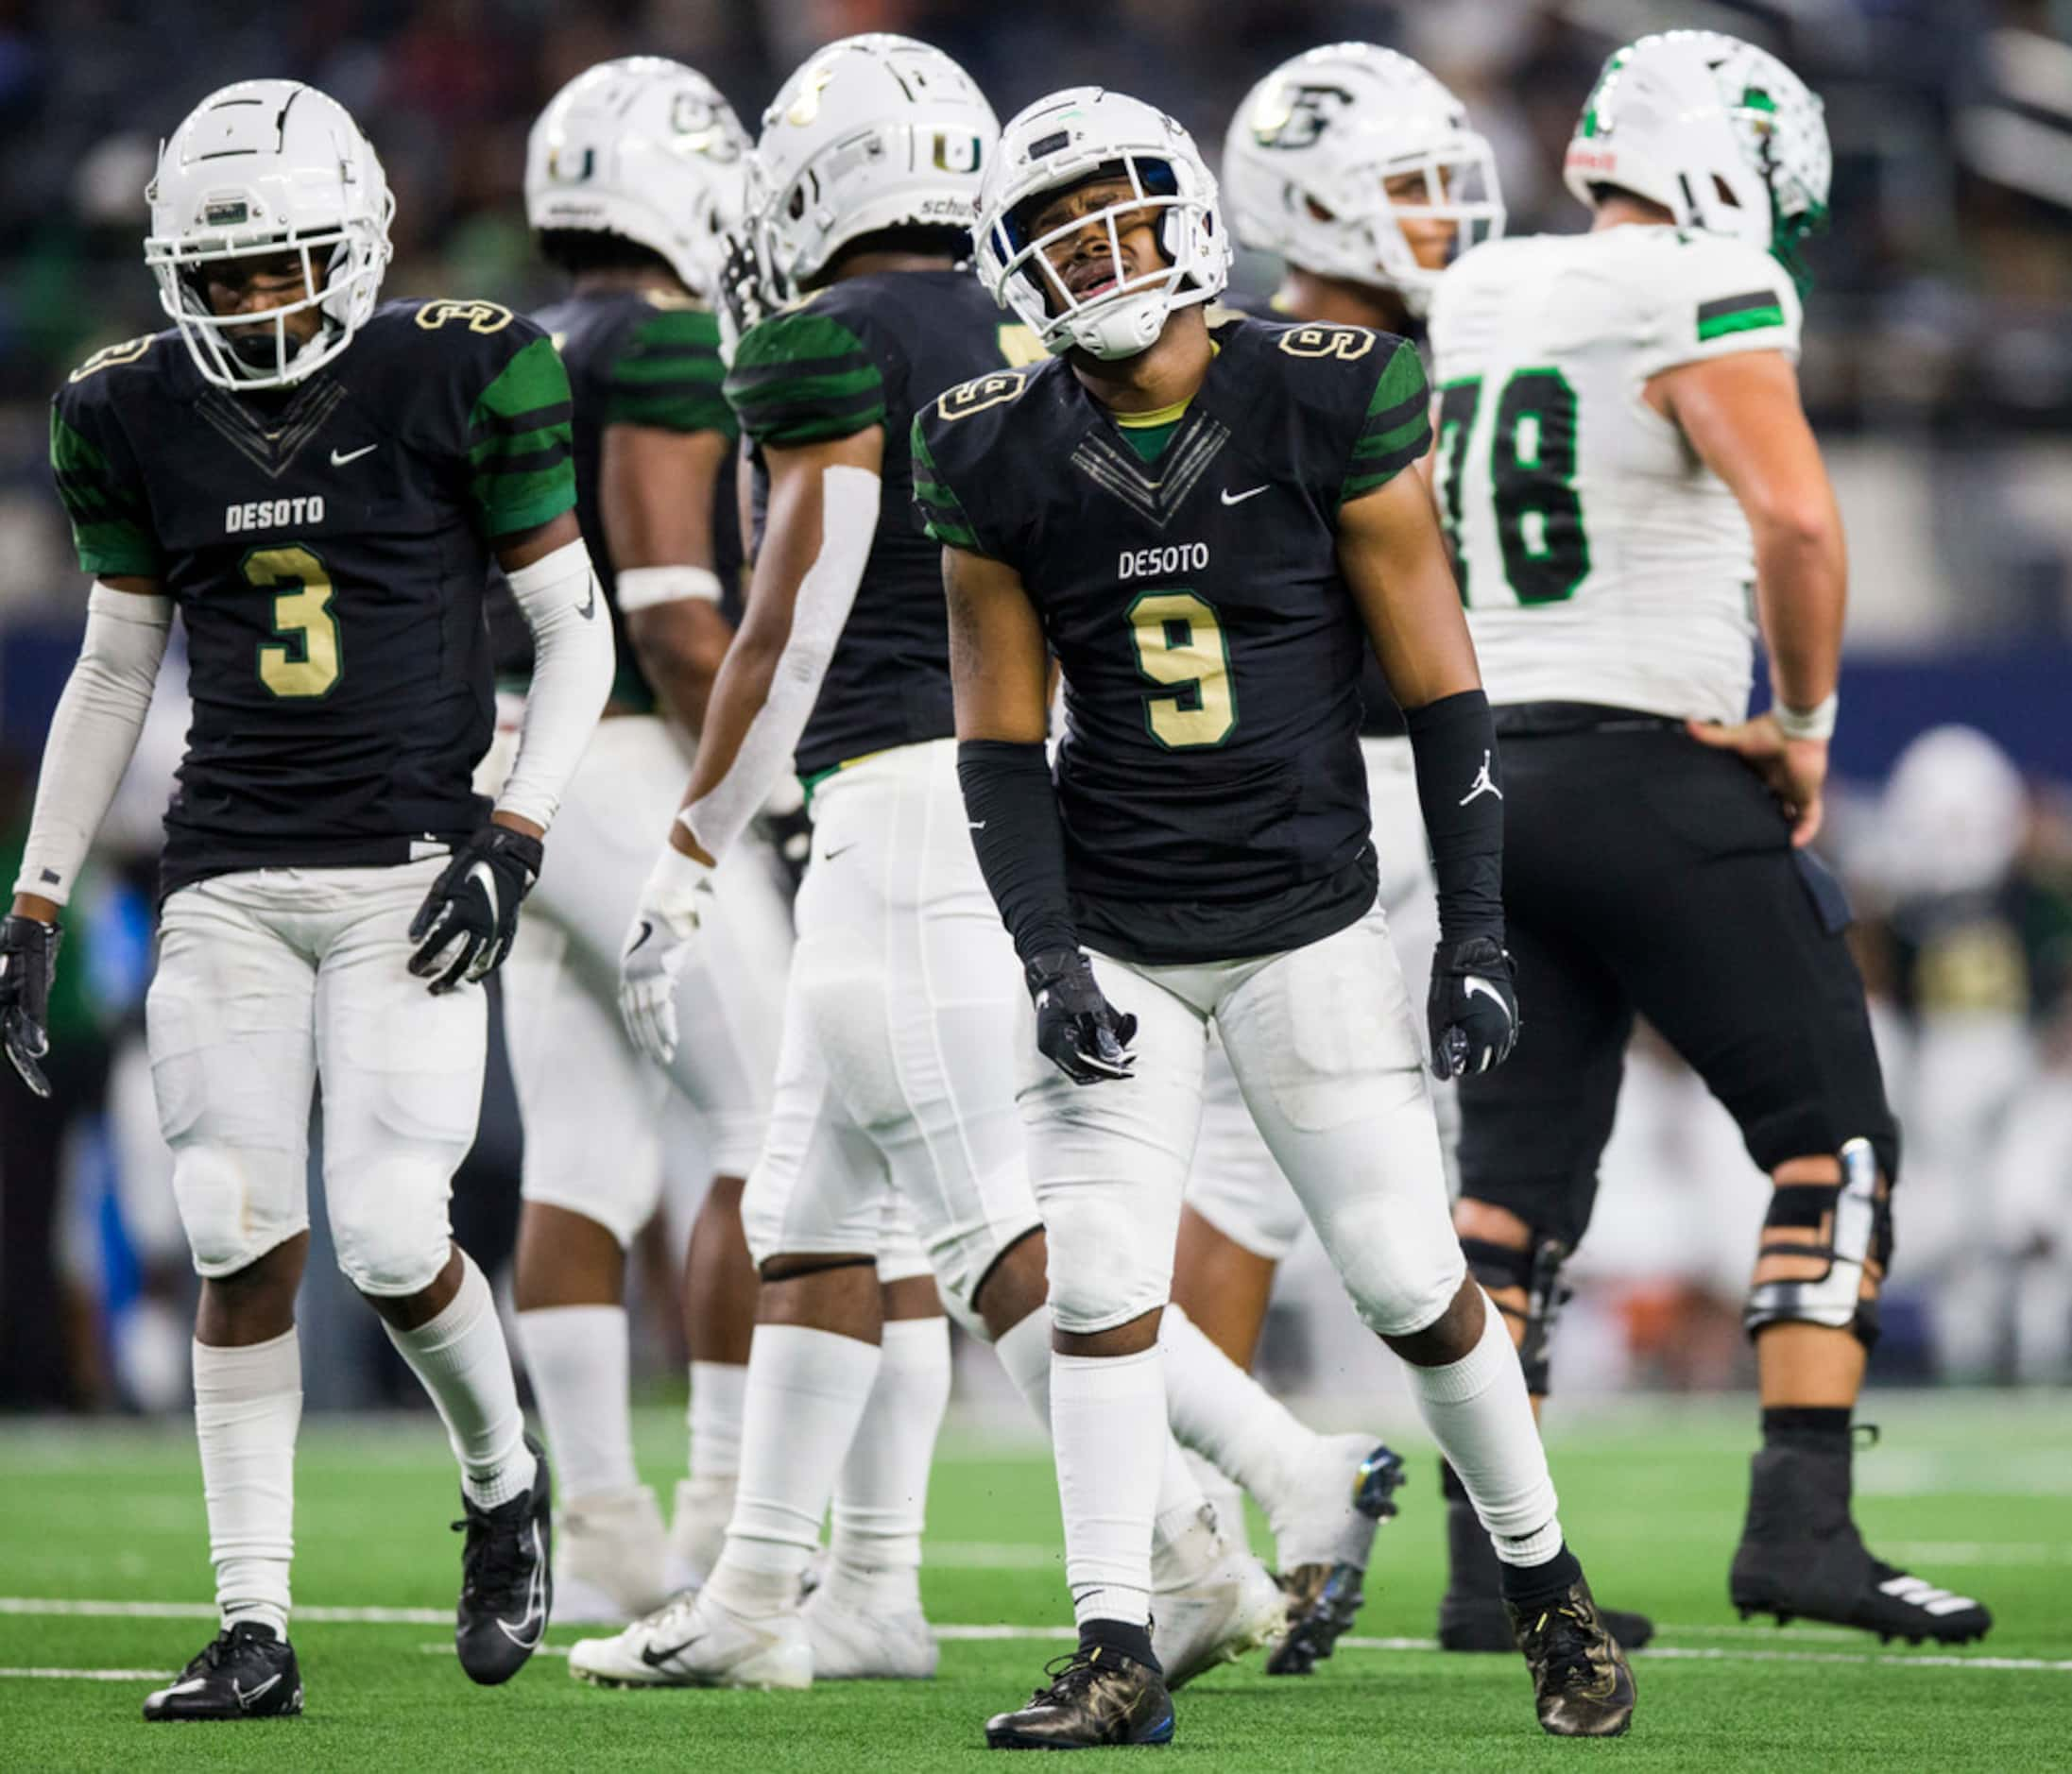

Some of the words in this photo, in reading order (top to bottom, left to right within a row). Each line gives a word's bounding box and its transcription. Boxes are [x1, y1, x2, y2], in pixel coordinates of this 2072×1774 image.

[414, 299, 515, 334] 3
[1277, 322, 1377, 361] 9
[937, 370, 1027, 421] 9
[1435, 367, 1592, 609] 78
[225, 495, 325, 534] DESOTO
[1118, 541, 1210, 580] DESOTO
[239, 540, 344, 699] 3
[1123, 588, 1239, 753] 9
